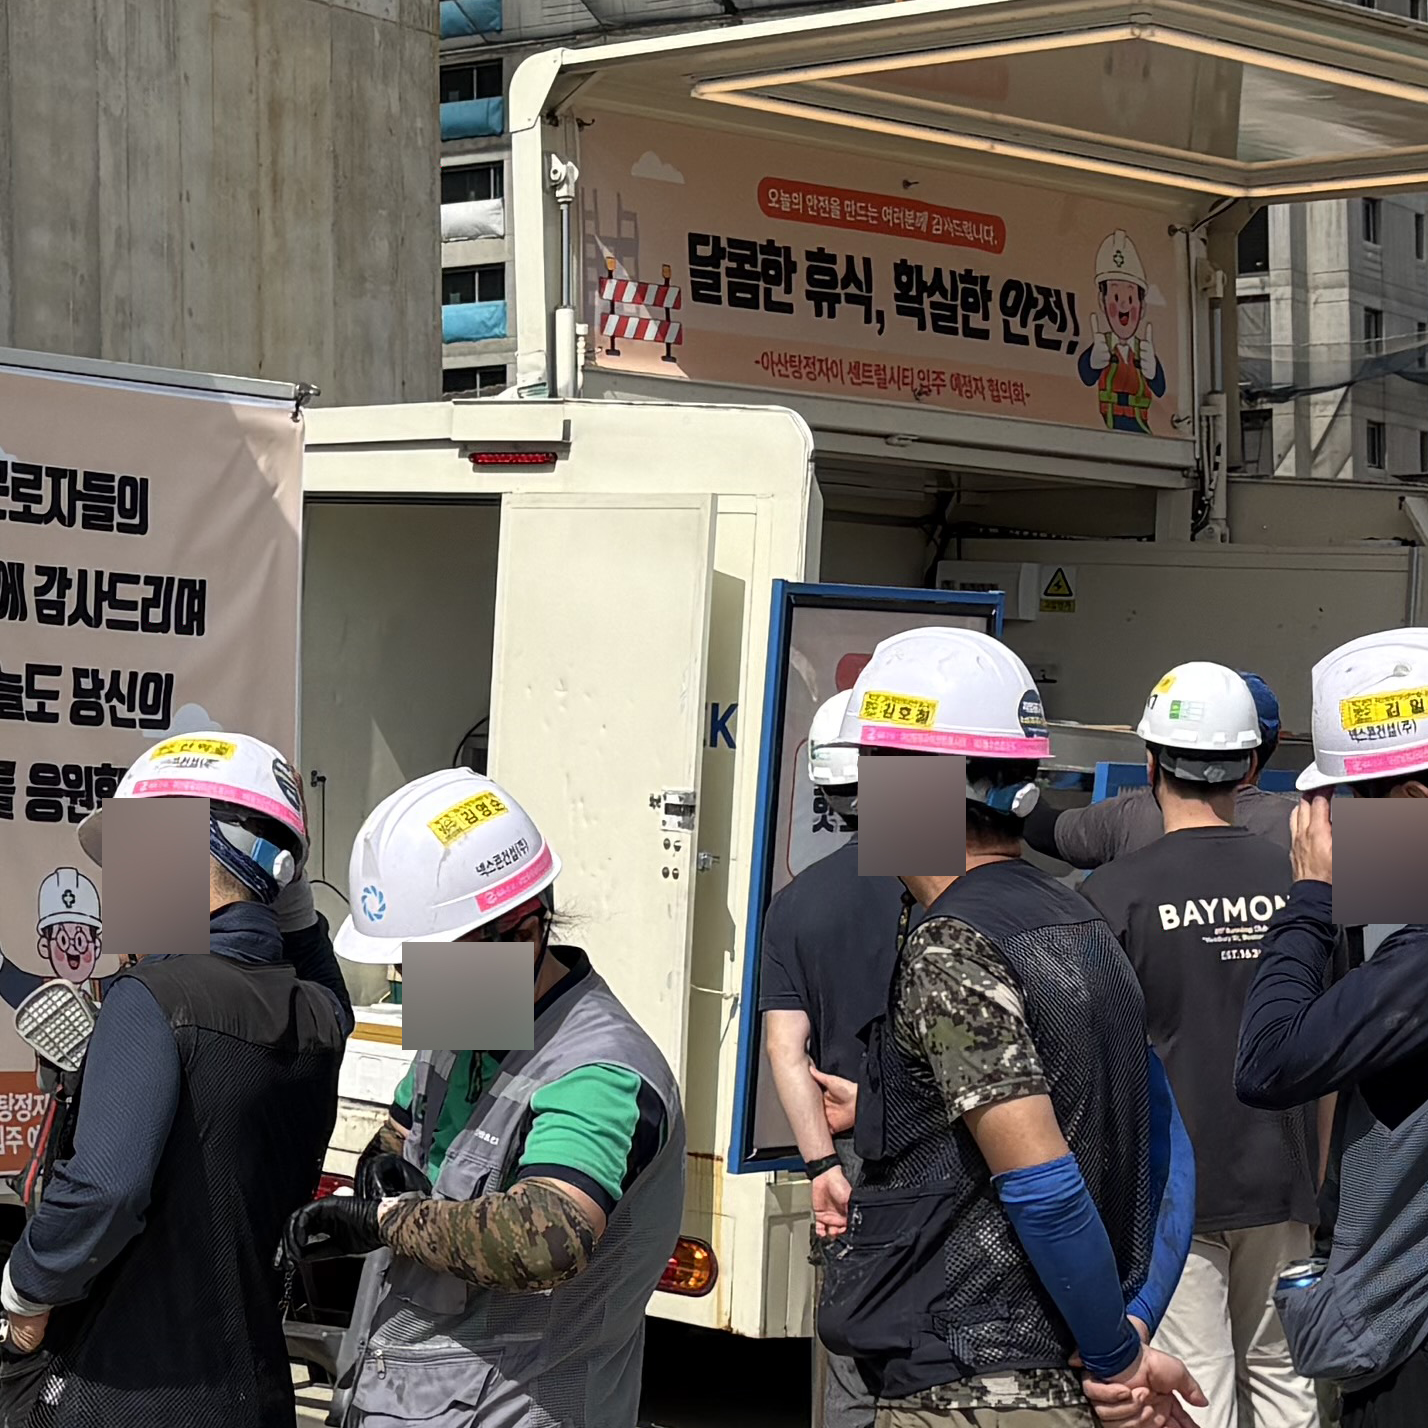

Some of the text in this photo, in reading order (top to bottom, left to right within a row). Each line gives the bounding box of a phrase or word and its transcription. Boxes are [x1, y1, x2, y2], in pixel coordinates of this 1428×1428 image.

[767, 187, 999, 247] 오늘의 안전을 만드는 여러분께 감사드립니다.
[687, 231, 1081, 356] 달콤한 휴식, 확실한 안전!
[847, 360, 916, 392] 센트럴시티
[917, 369, 947, 397] 입주
[949, 373, 986, 402] 예정자
[33, 564, 207, 637] 감사드리며
[68, 666, 175, 731] 당신의
